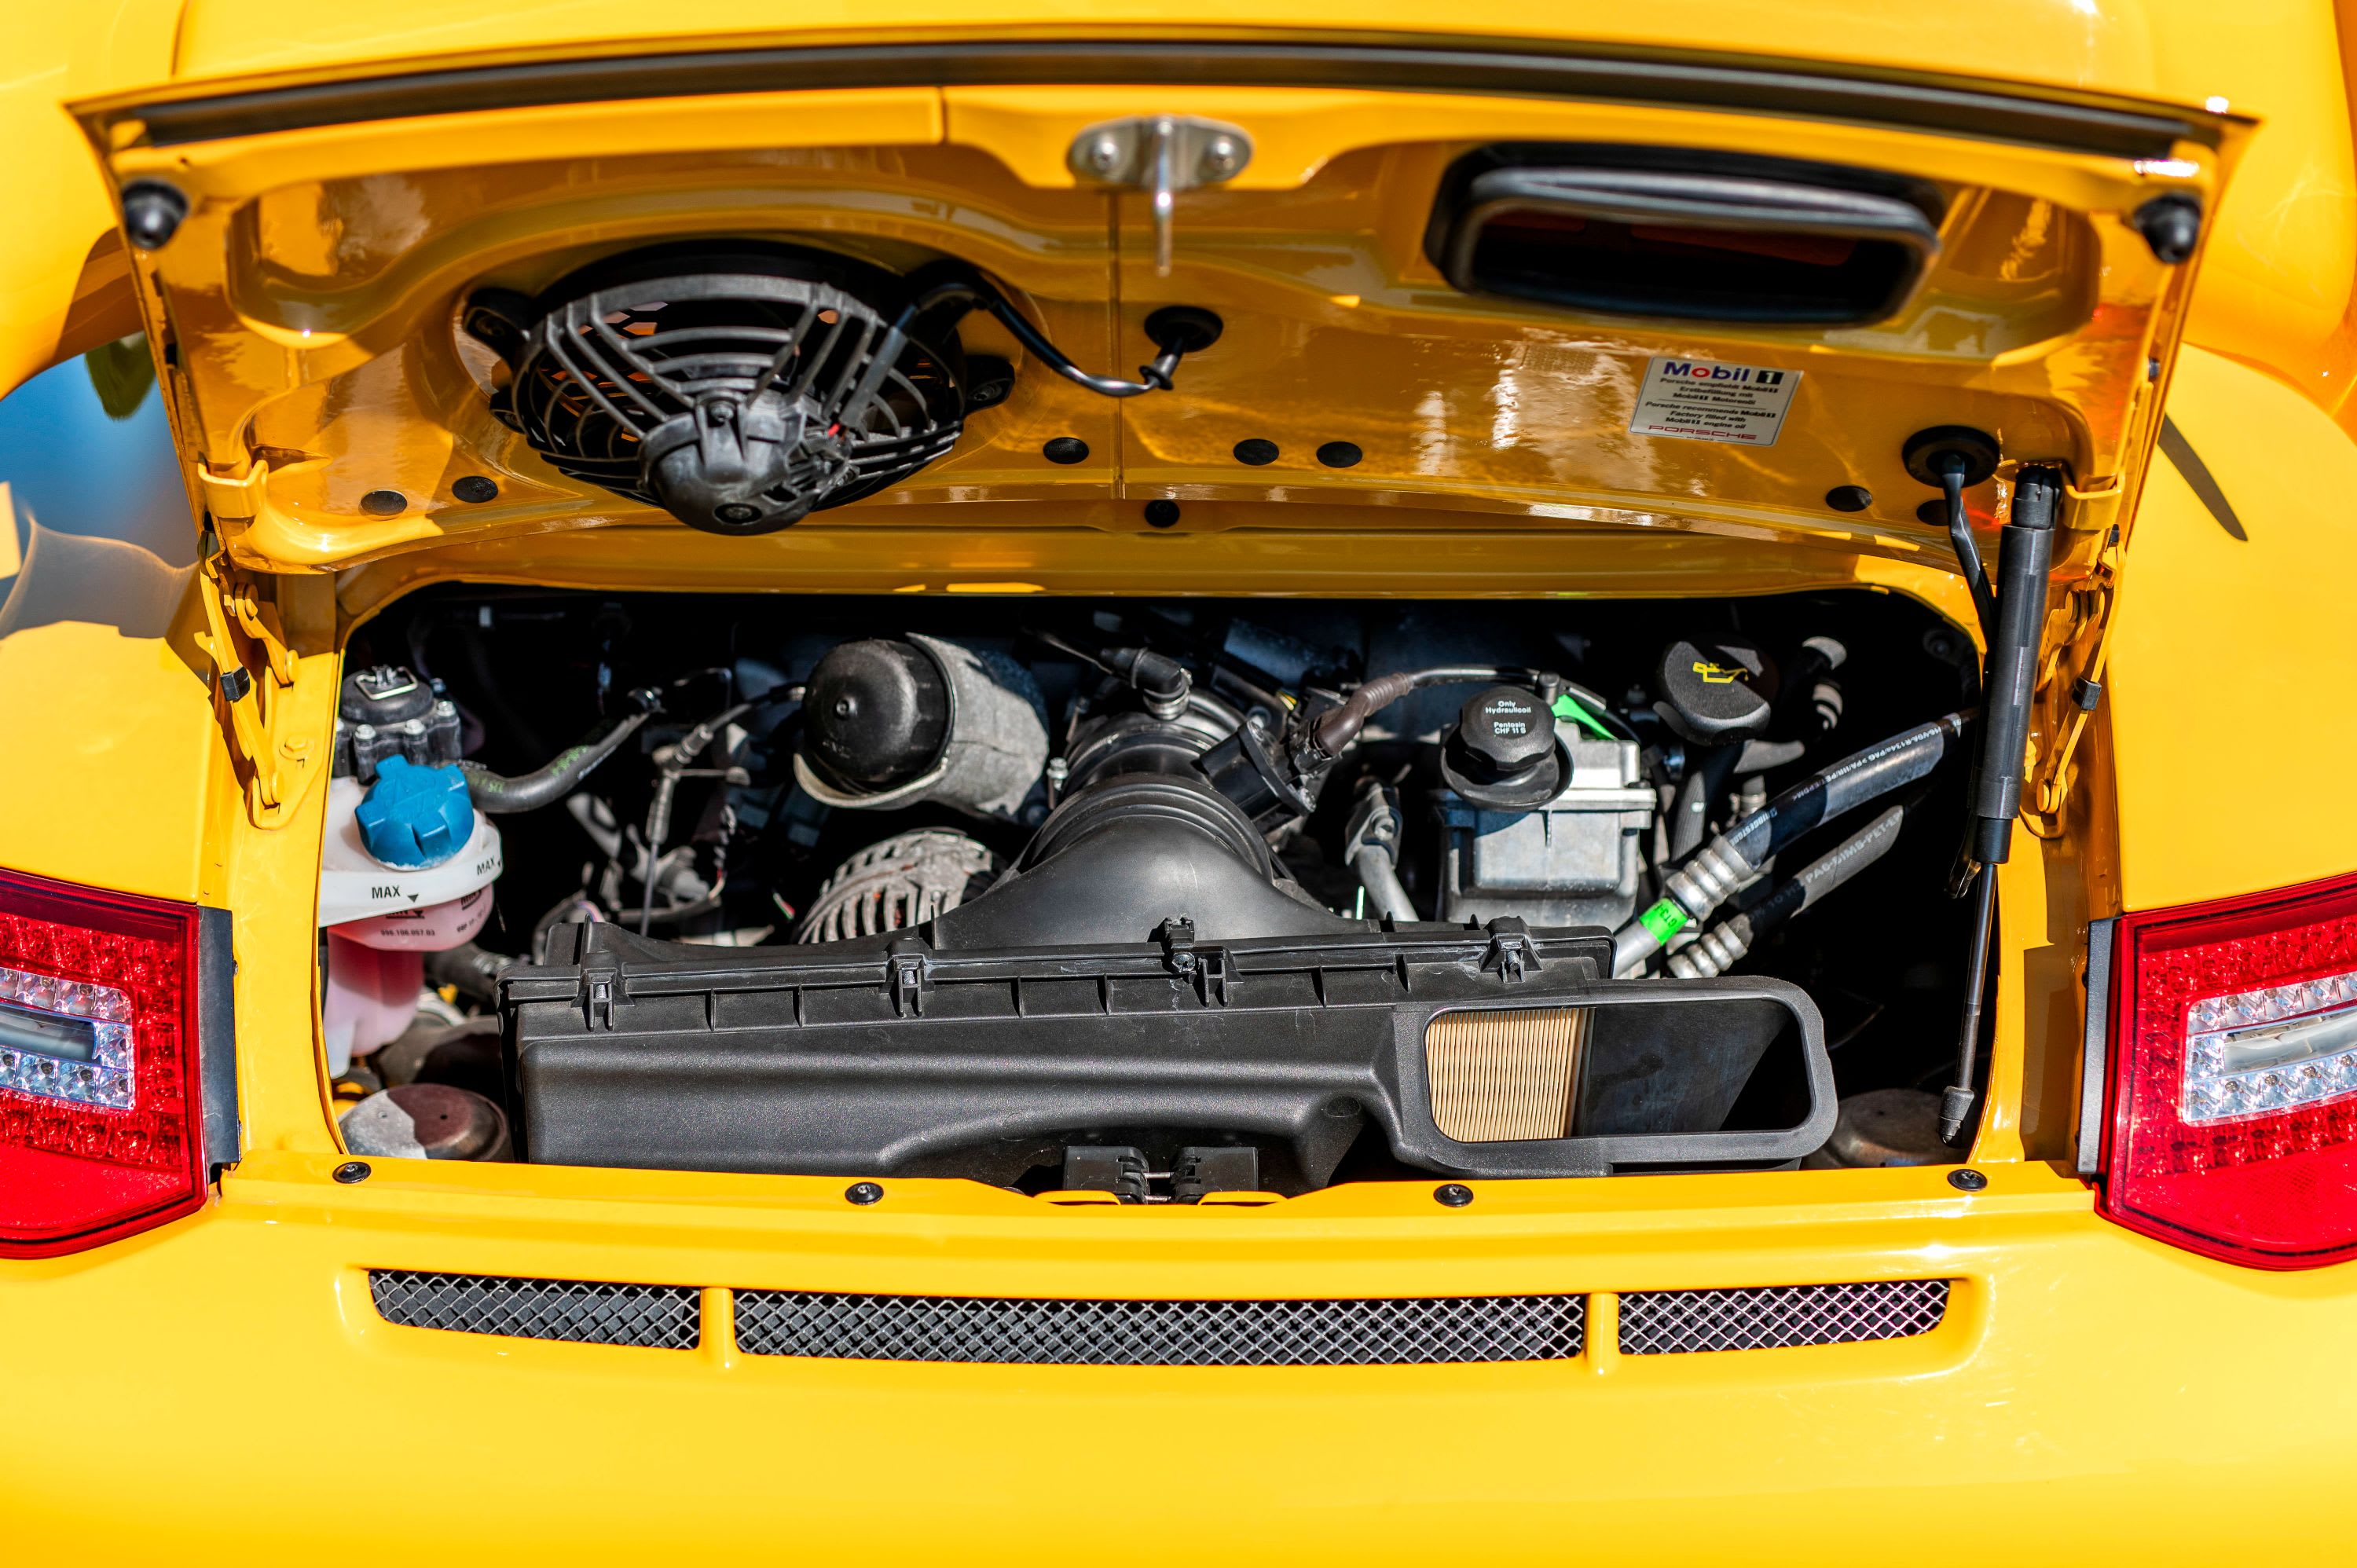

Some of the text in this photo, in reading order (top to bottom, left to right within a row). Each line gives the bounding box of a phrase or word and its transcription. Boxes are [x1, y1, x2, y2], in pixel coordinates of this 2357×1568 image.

[1663, 361, 1750, 382] Mobil
[1645, 401, 1681, 409] Porsche
[1683, 405, 1739, 415] recommends
[1670, 410, 1703, 419] Factory
[1648, 425, 1758, 440] PORSCHE
[1485, 706, 1531, 715] Hydraulicoil
[476, 855, 495, 876] MAX
[372, 885, 401, 899] MAX
